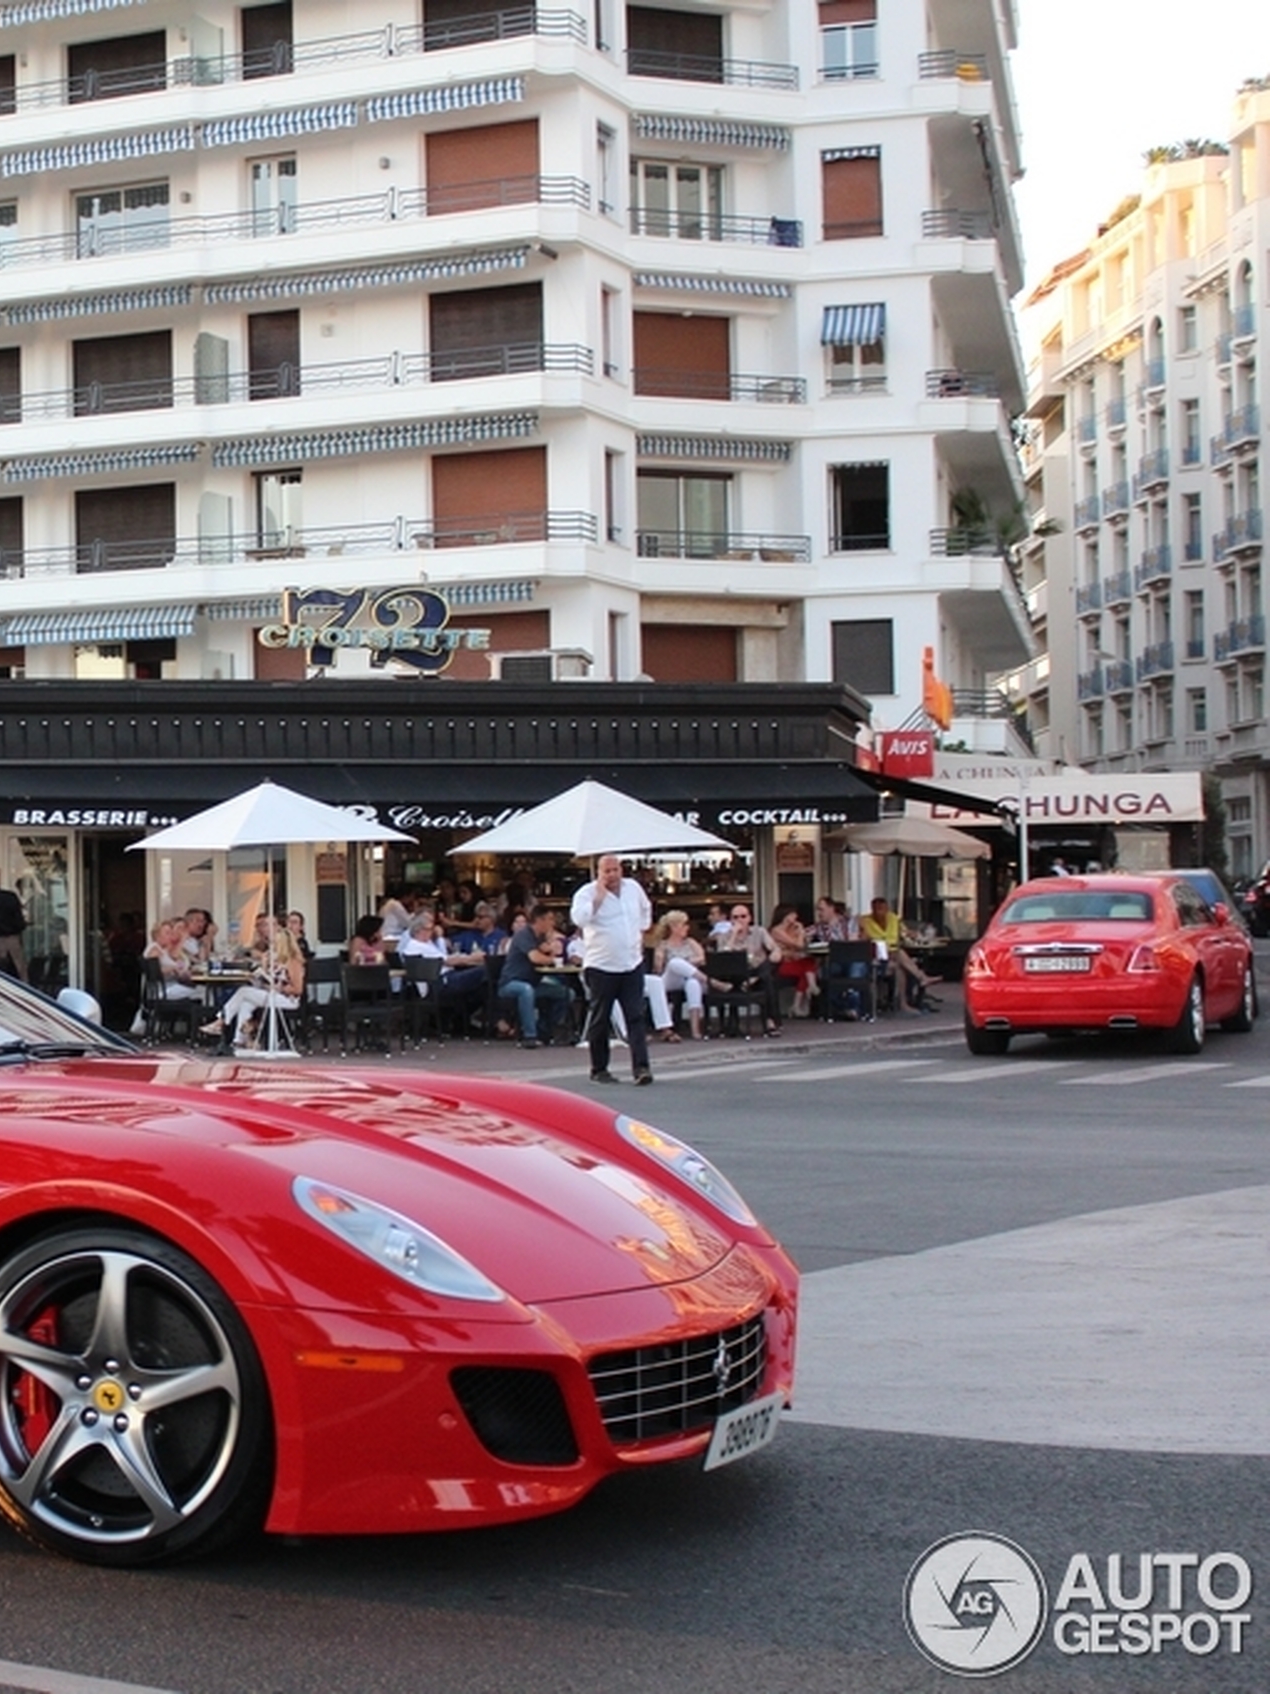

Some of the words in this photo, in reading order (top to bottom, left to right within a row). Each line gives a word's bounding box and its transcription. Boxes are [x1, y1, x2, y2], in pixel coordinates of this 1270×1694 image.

[258, 624, 491, 650] CROISETTE
[282, 585, 454, 674] 72
[887, 738, 928, 755] AVIS
[956, 766, 1045, 780] CHUNA
